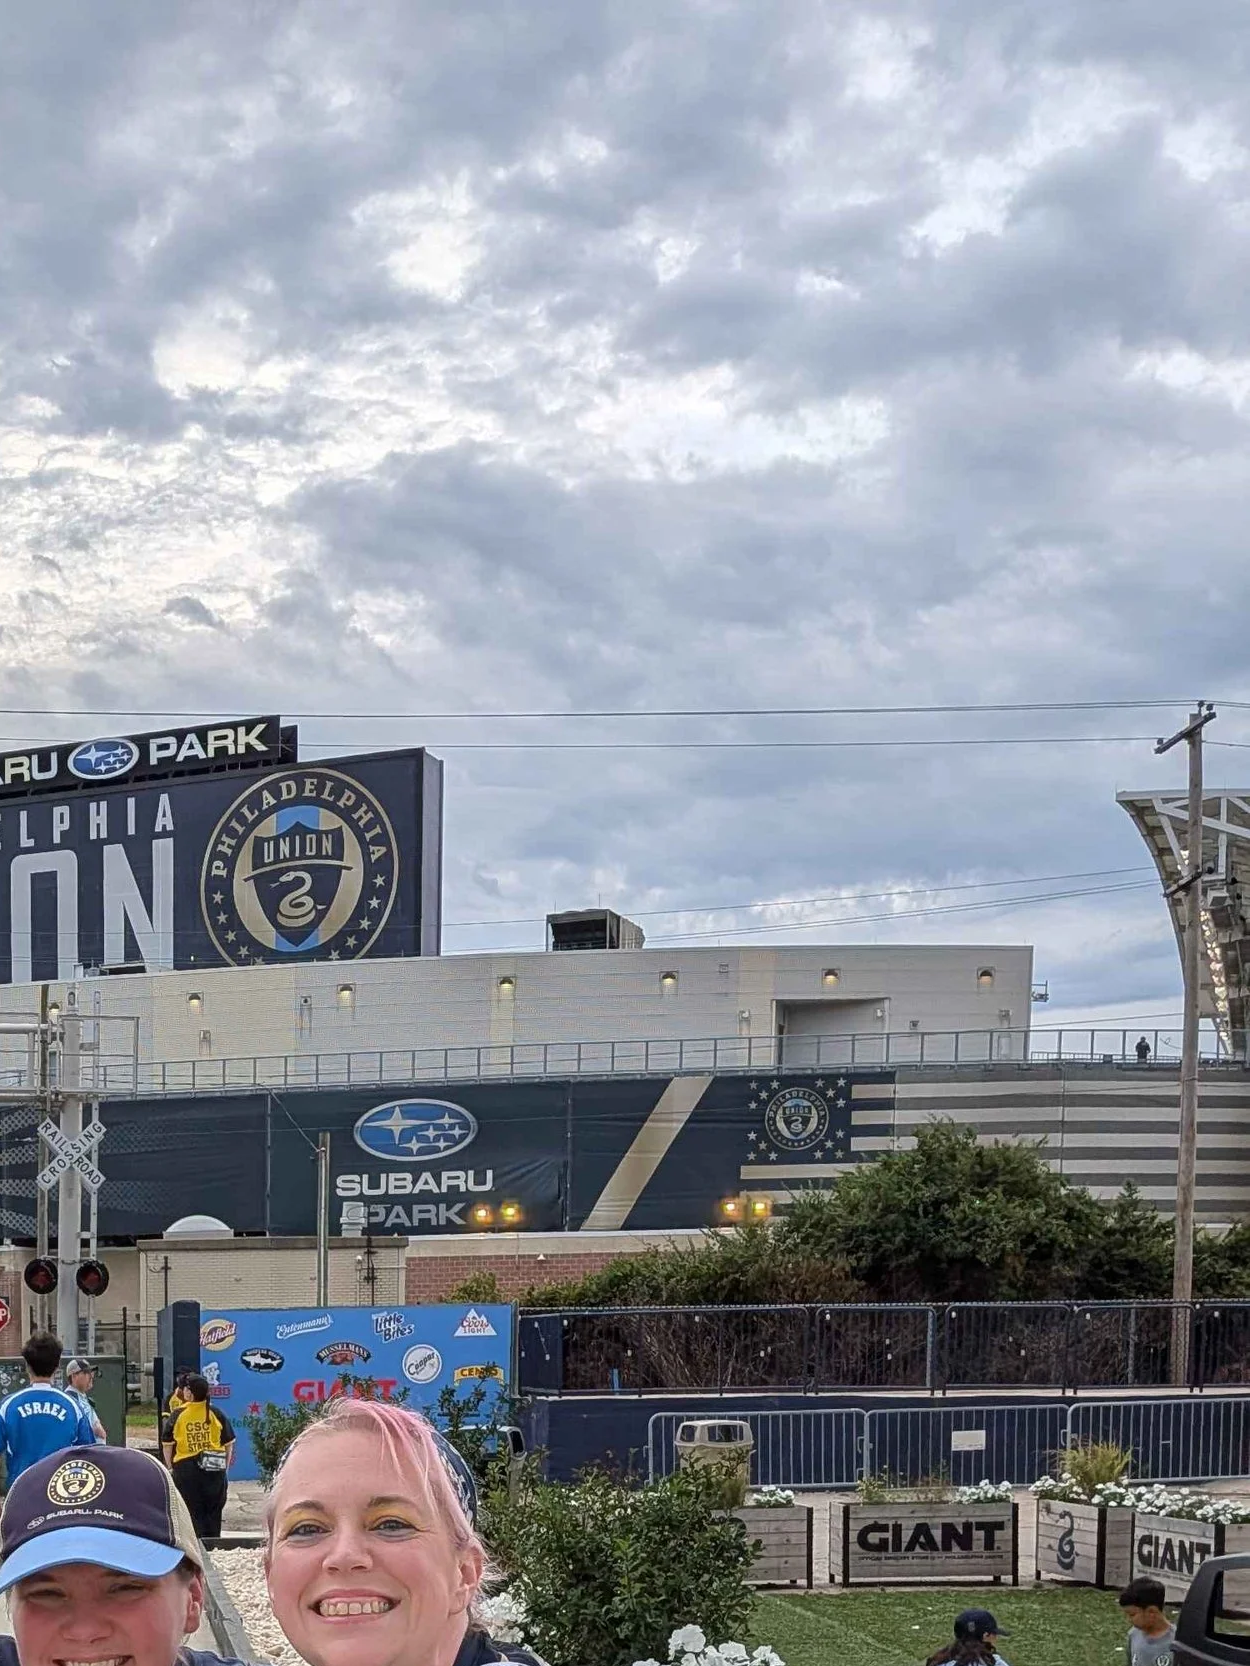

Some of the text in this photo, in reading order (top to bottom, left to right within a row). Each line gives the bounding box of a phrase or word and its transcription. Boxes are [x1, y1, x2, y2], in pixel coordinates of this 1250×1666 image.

[149, 722, 270, 766] PARK
[211, 778, 388, 879] PHILADELPHIA
[263, 833, 333, 864] UNION
[40, 1121, 104, 1184] CROSSING
[336, 1169, 494, 1197] SUBARU
[199, 1322, 237, 1347] Hatfield
[374, 1311, 405, 1332] Little
[383, 1323, 415, 1343] Bites
[17, 1401, 68, 1422] ISRAEL
[186, 1421, 210, 1432] CSC
[186, 1432, 211, 1443] EVENT
[46, 1508, 124, 1520] SUBARU PARK
[856, 1520, 1006, 1552] GIANT
[1137, 1534, 1212, 1575] GIANT
